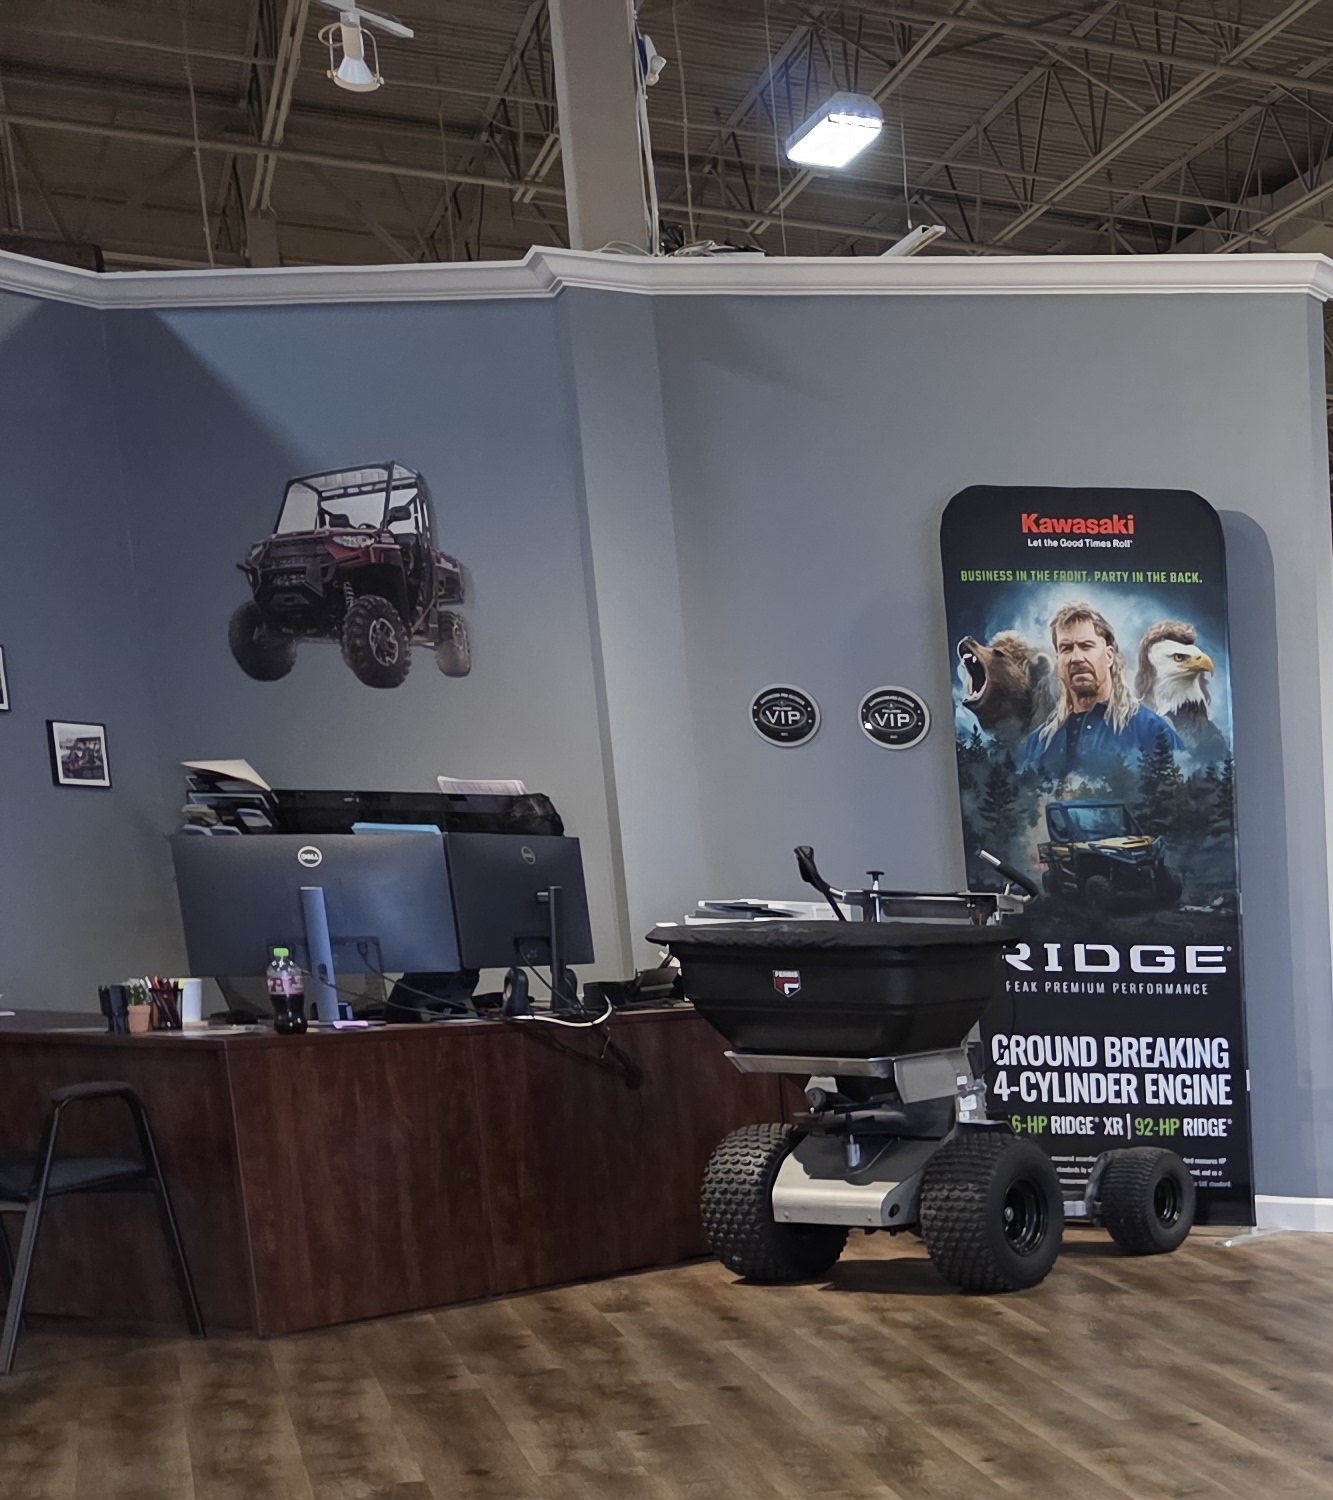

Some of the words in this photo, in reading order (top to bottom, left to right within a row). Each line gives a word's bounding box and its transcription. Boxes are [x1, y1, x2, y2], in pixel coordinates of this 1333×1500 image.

[1021, 513, 1135, 535] Kawasaki
[1027, 538, 1042, 547] Let
[1044, 538, 1058, 547] the
[1059, 538, 1083, 548] Good
[1085, 539, 1111, 548] Times
[960, 570, 1013, 582] BUSINESS
[1016, 570, 1027, 582] IN
[1030, 570, 1050, 582] THE
[1053, 570, 1091, 583] FRONT.
[1094, 571, 1128, 583] PARTY
[1132, 571, 1143, 583] IN
[1147, 572, 1167, 583] THE
[1170, 572, 1202, 584] BACK.
[765, 710, 800, 725] VIP
[874, 713, 910, 727] VIP
[1002, 943, 1227, 974] RIDGE
[1044, 981, 1105, 994] PREMIUM
[1112, 982, 1209, 995] PERFORMANCE
[991, 1033, 1098, 1067] GROUND
[1103, 1036, 1230, 1069] BREAKING
[993, 1071, 1139, 1104] 4-CYLINDER
[1144, 1073, 1233, 1106] ENGINE
[1008, 1114, 1048, 1134] 6-HP
[1103, 1117, 1124, 1136] XR
[1135, 1118, 1180, 1136] 92-HP
